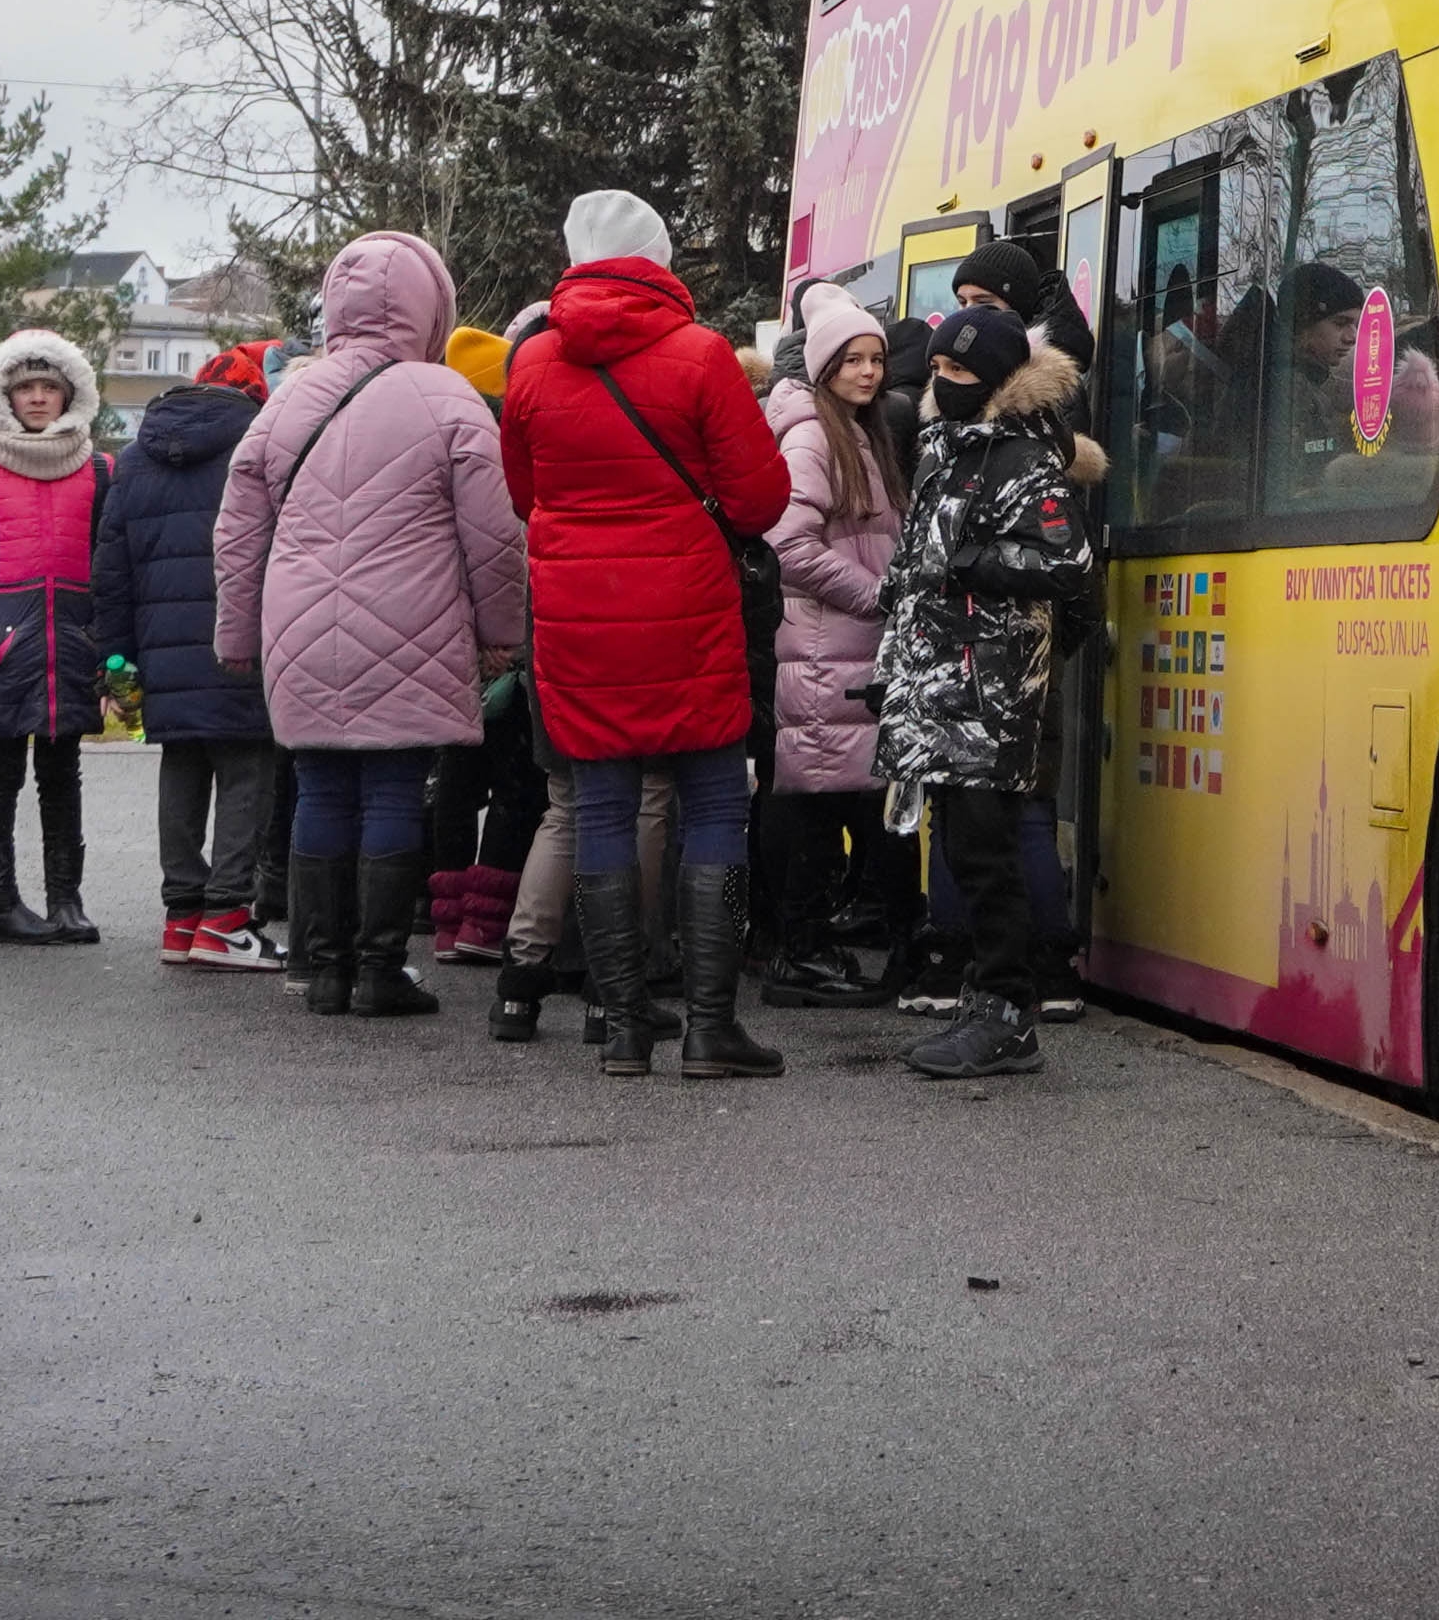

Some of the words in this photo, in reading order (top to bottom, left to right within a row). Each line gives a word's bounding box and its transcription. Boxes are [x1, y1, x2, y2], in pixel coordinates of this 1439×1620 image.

[941, 4, 1029, 188] Hop
[1285, 568, 1310, 601] BUY
[1311, 565, 1376, 601] VINNYTSIA
[1379, 563, 1431, 599] TICKETS
[1336, 620, 1430, 658] BUSPASS.VN.UA
